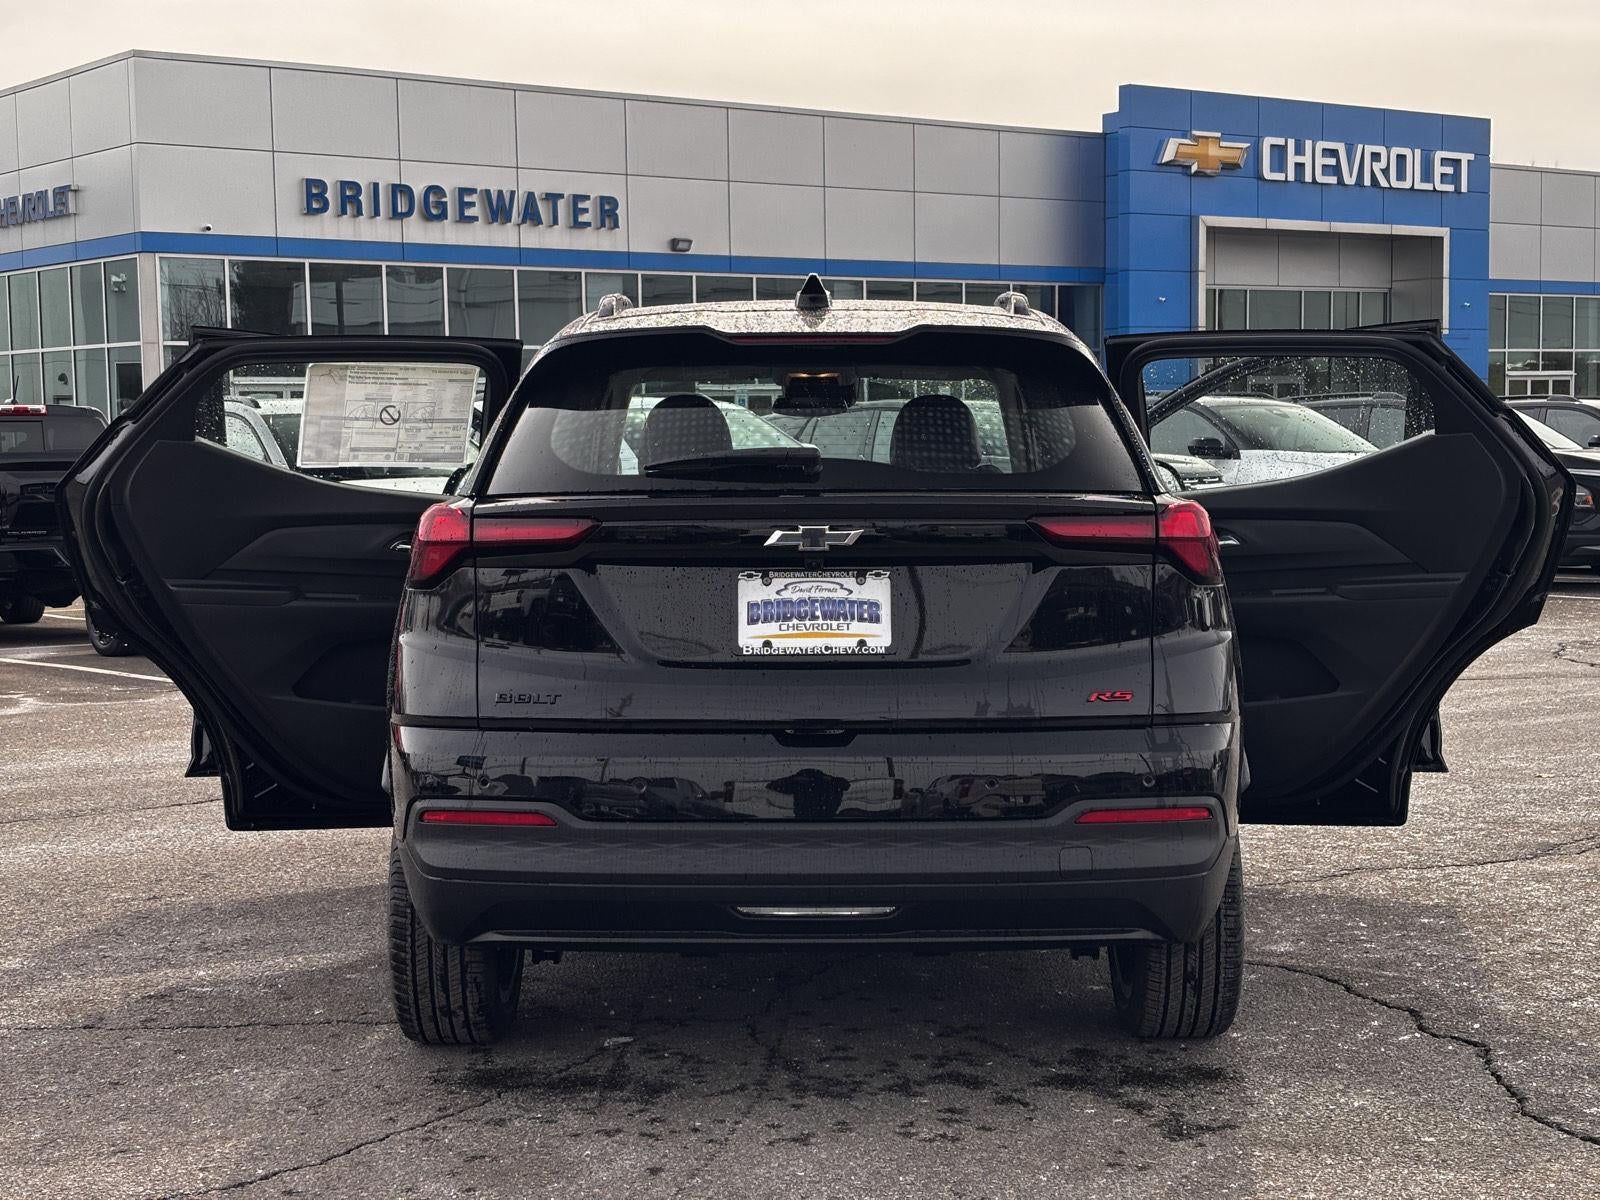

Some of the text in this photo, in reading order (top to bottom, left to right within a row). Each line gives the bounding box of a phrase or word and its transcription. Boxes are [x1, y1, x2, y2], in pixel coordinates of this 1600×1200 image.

[1262, 136, 1475, 193] CHEVROLET
[0, 184, 79, 228] HEVROLET
[302, 177, 620, 230] BRIDGEWATER
[790, 584, 813, 594] David
[747, 597, 882, 625] BRIDGEWATER
[778, 622, 852, 632] CHEVROLET
[495, 693, 562, 704] BOLT
[1086, 690, 1134, 703] RS
